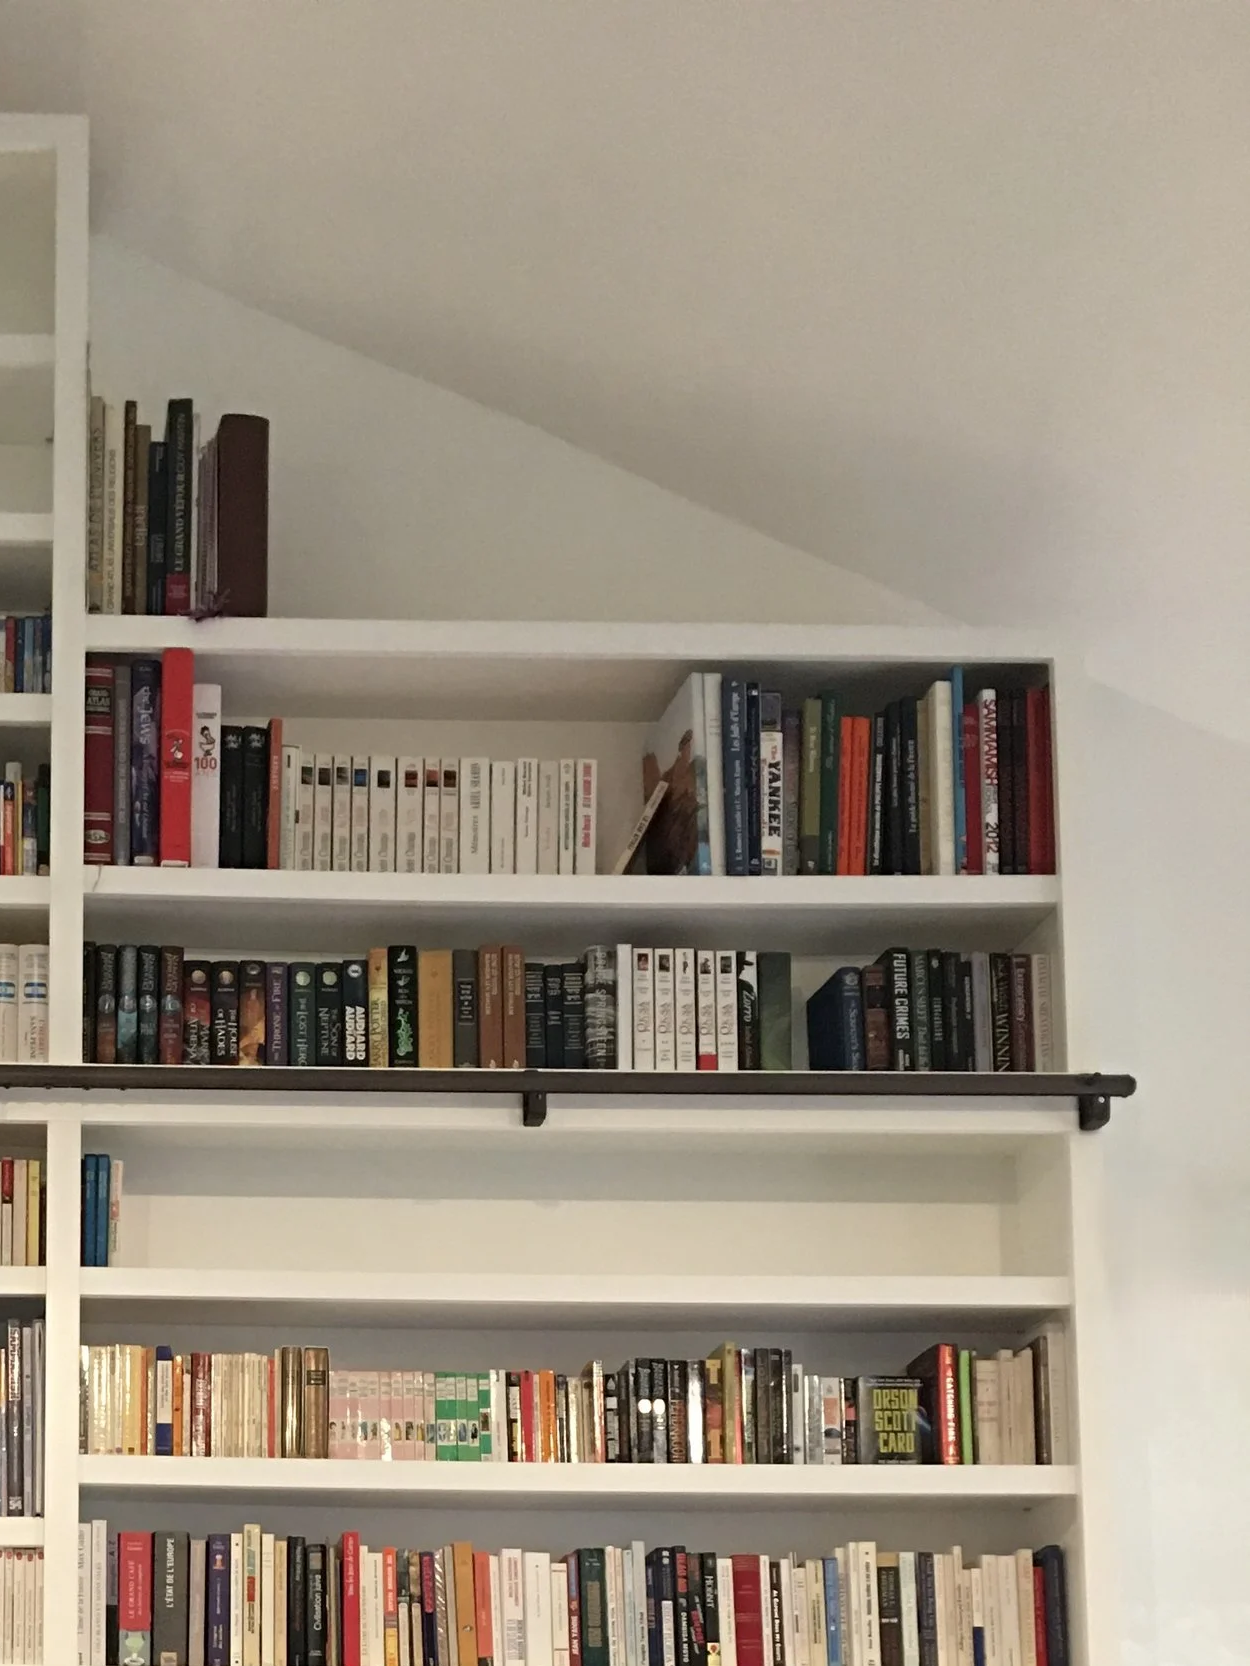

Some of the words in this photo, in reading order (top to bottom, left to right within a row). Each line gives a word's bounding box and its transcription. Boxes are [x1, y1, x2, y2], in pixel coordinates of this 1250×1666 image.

[175, 518, 184, 556] GRAND
[174, 557, 184, 571] LE
[194, 756, 217, 770] 100
[768, 761, 781, 837] YANKEE
[893, 953, 908, 995] FUTURE
[743, 990, 757, 1022] Zorro
[1014, 968, 1027, 1021] Extraordinary
[319, 1007, 329, 1057] NEPTUNE
[345, 1006, 355, 1060] AUDIARD
[355, 1006, 365, 1060] AUDIARD
[596, 989, 607, 1056] SPRINGSTEEN
[895, 998, 909, 1039] CRIMES
[994, 1014, 1008, 1071] WINNIN
[873, 1389, 918, 1409] ORSON
[946, 1377, 955, 1421] CATCHING
[874, 1410, 916, 1431] SCOTT
[947, 1422, 956, 1442] FIRE
[879, 1432, 915, 1453] CARD
[166, 1538, 175, 1573] L'EUROPE
[165, 1585, 174, 1608] L'ÉTAT
[166, 1574, 174, 1584] DE
[571, 1638, 579, 1655] JEAN
